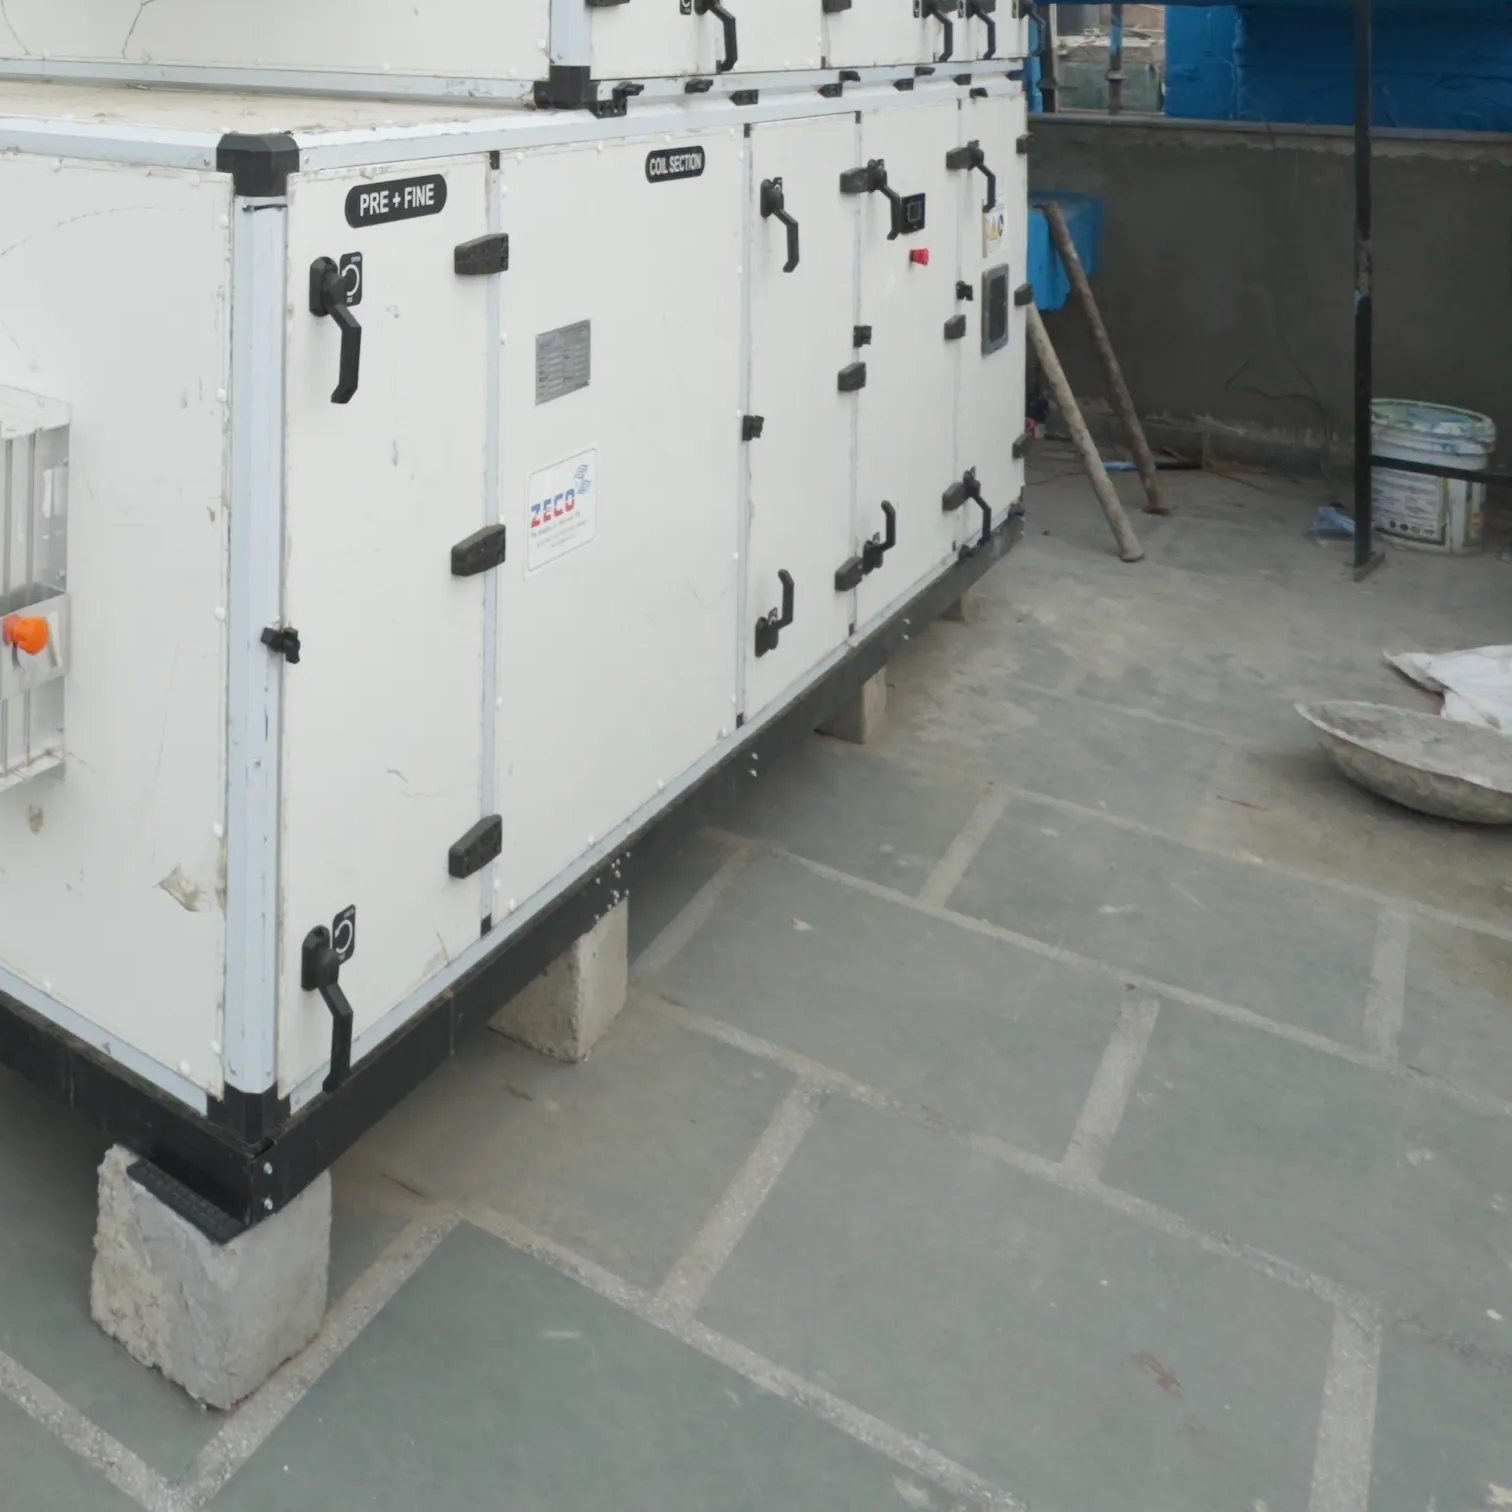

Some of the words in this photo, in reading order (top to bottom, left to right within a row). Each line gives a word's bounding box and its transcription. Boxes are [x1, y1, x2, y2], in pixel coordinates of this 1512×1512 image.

[649, 157, 668, 176] COIL
[669, 152, 702, 174] SECTION
[359, 190, 389, 217] PRE
[392, 191, 401, 208] +
[404, 183, 435, 209] FINE
[530, 487, 575, 529] ZECO
